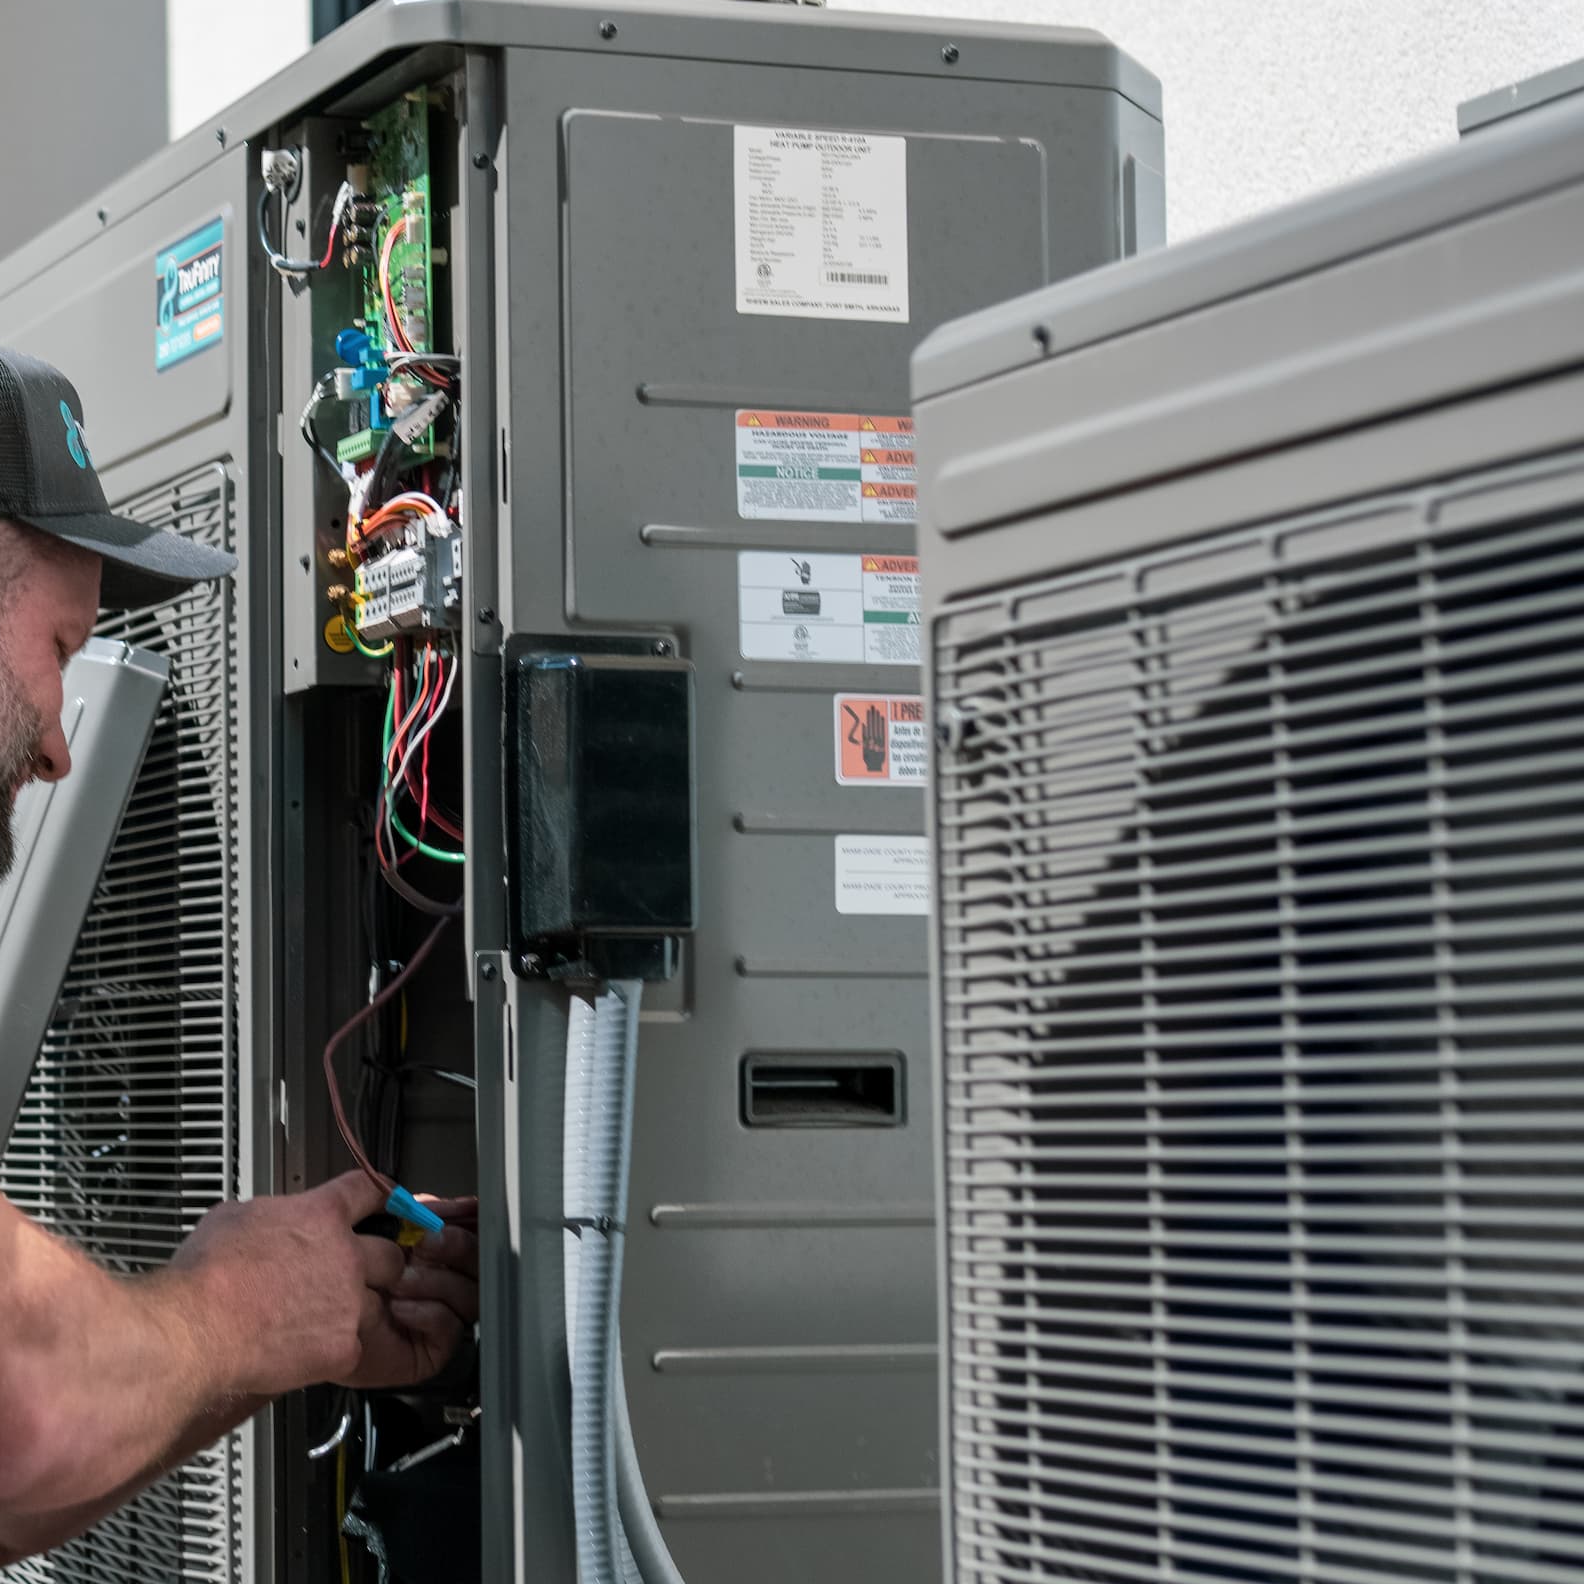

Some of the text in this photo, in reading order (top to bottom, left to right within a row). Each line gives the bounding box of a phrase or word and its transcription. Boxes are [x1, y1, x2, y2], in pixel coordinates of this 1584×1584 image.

[775, 131, 812, 141] VARIABLE
[815, 134, 837, 142] SPEED
[770, 140, 871, 154] HEAT PUMP OUTDOOR UNIT
[775, 416, 830, 428] WARNING
[751, 430, 848, 440] HAZARDOUS VOLTAGE
[776, 466, 818, 479] NOTICE
